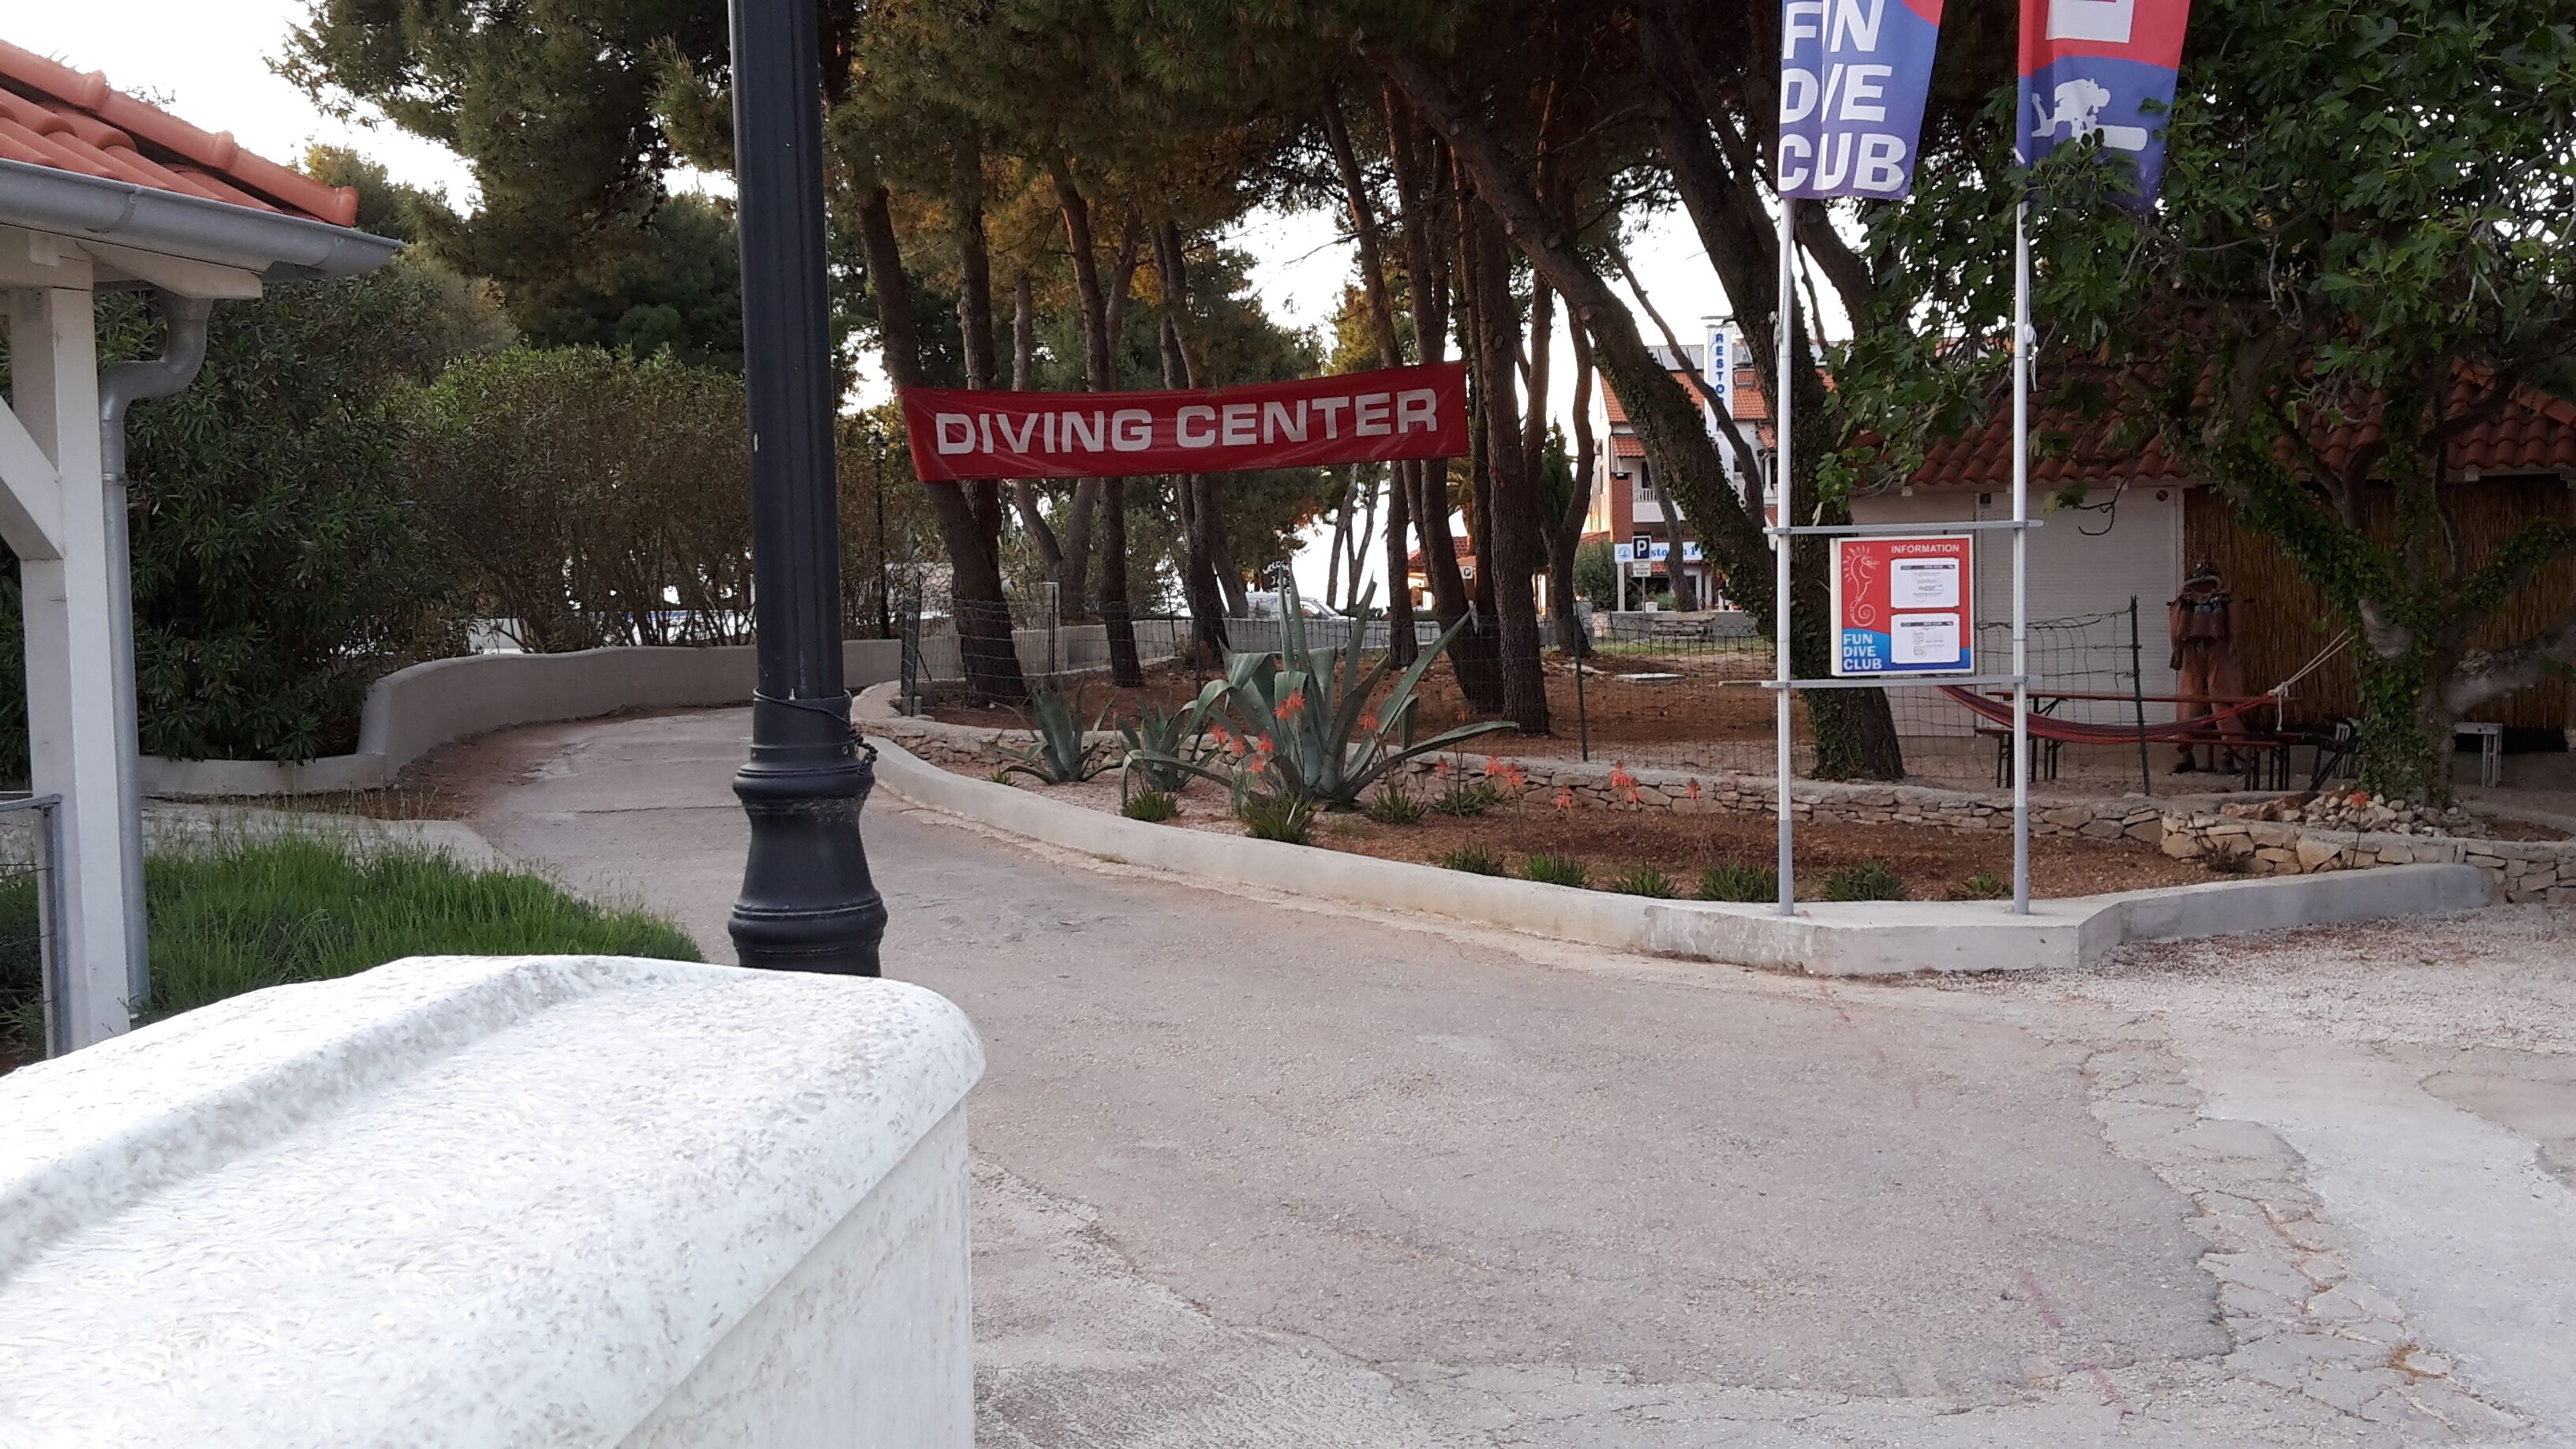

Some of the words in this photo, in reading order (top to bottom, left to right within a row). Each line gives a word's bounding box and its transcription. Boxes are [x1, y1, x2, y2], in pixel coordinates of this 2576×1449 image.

[1783, 0, 1885, 59] FN
[1779, 63, 1893, 124] DVE
[1715, 333, 1725, 432] RESTO
[935, 410, 1153, 455] DIVING
[1176, 388, 1438, 448] CENTER
[1637, 540, 1647, 557] P
[1891, 543, 1960, 553] INFORMATION
[1843, 633, 1874, 646] FUN
[1843, 646, 1878, 657] DIVE
[1843, 657, 1883, 670] CLUB
